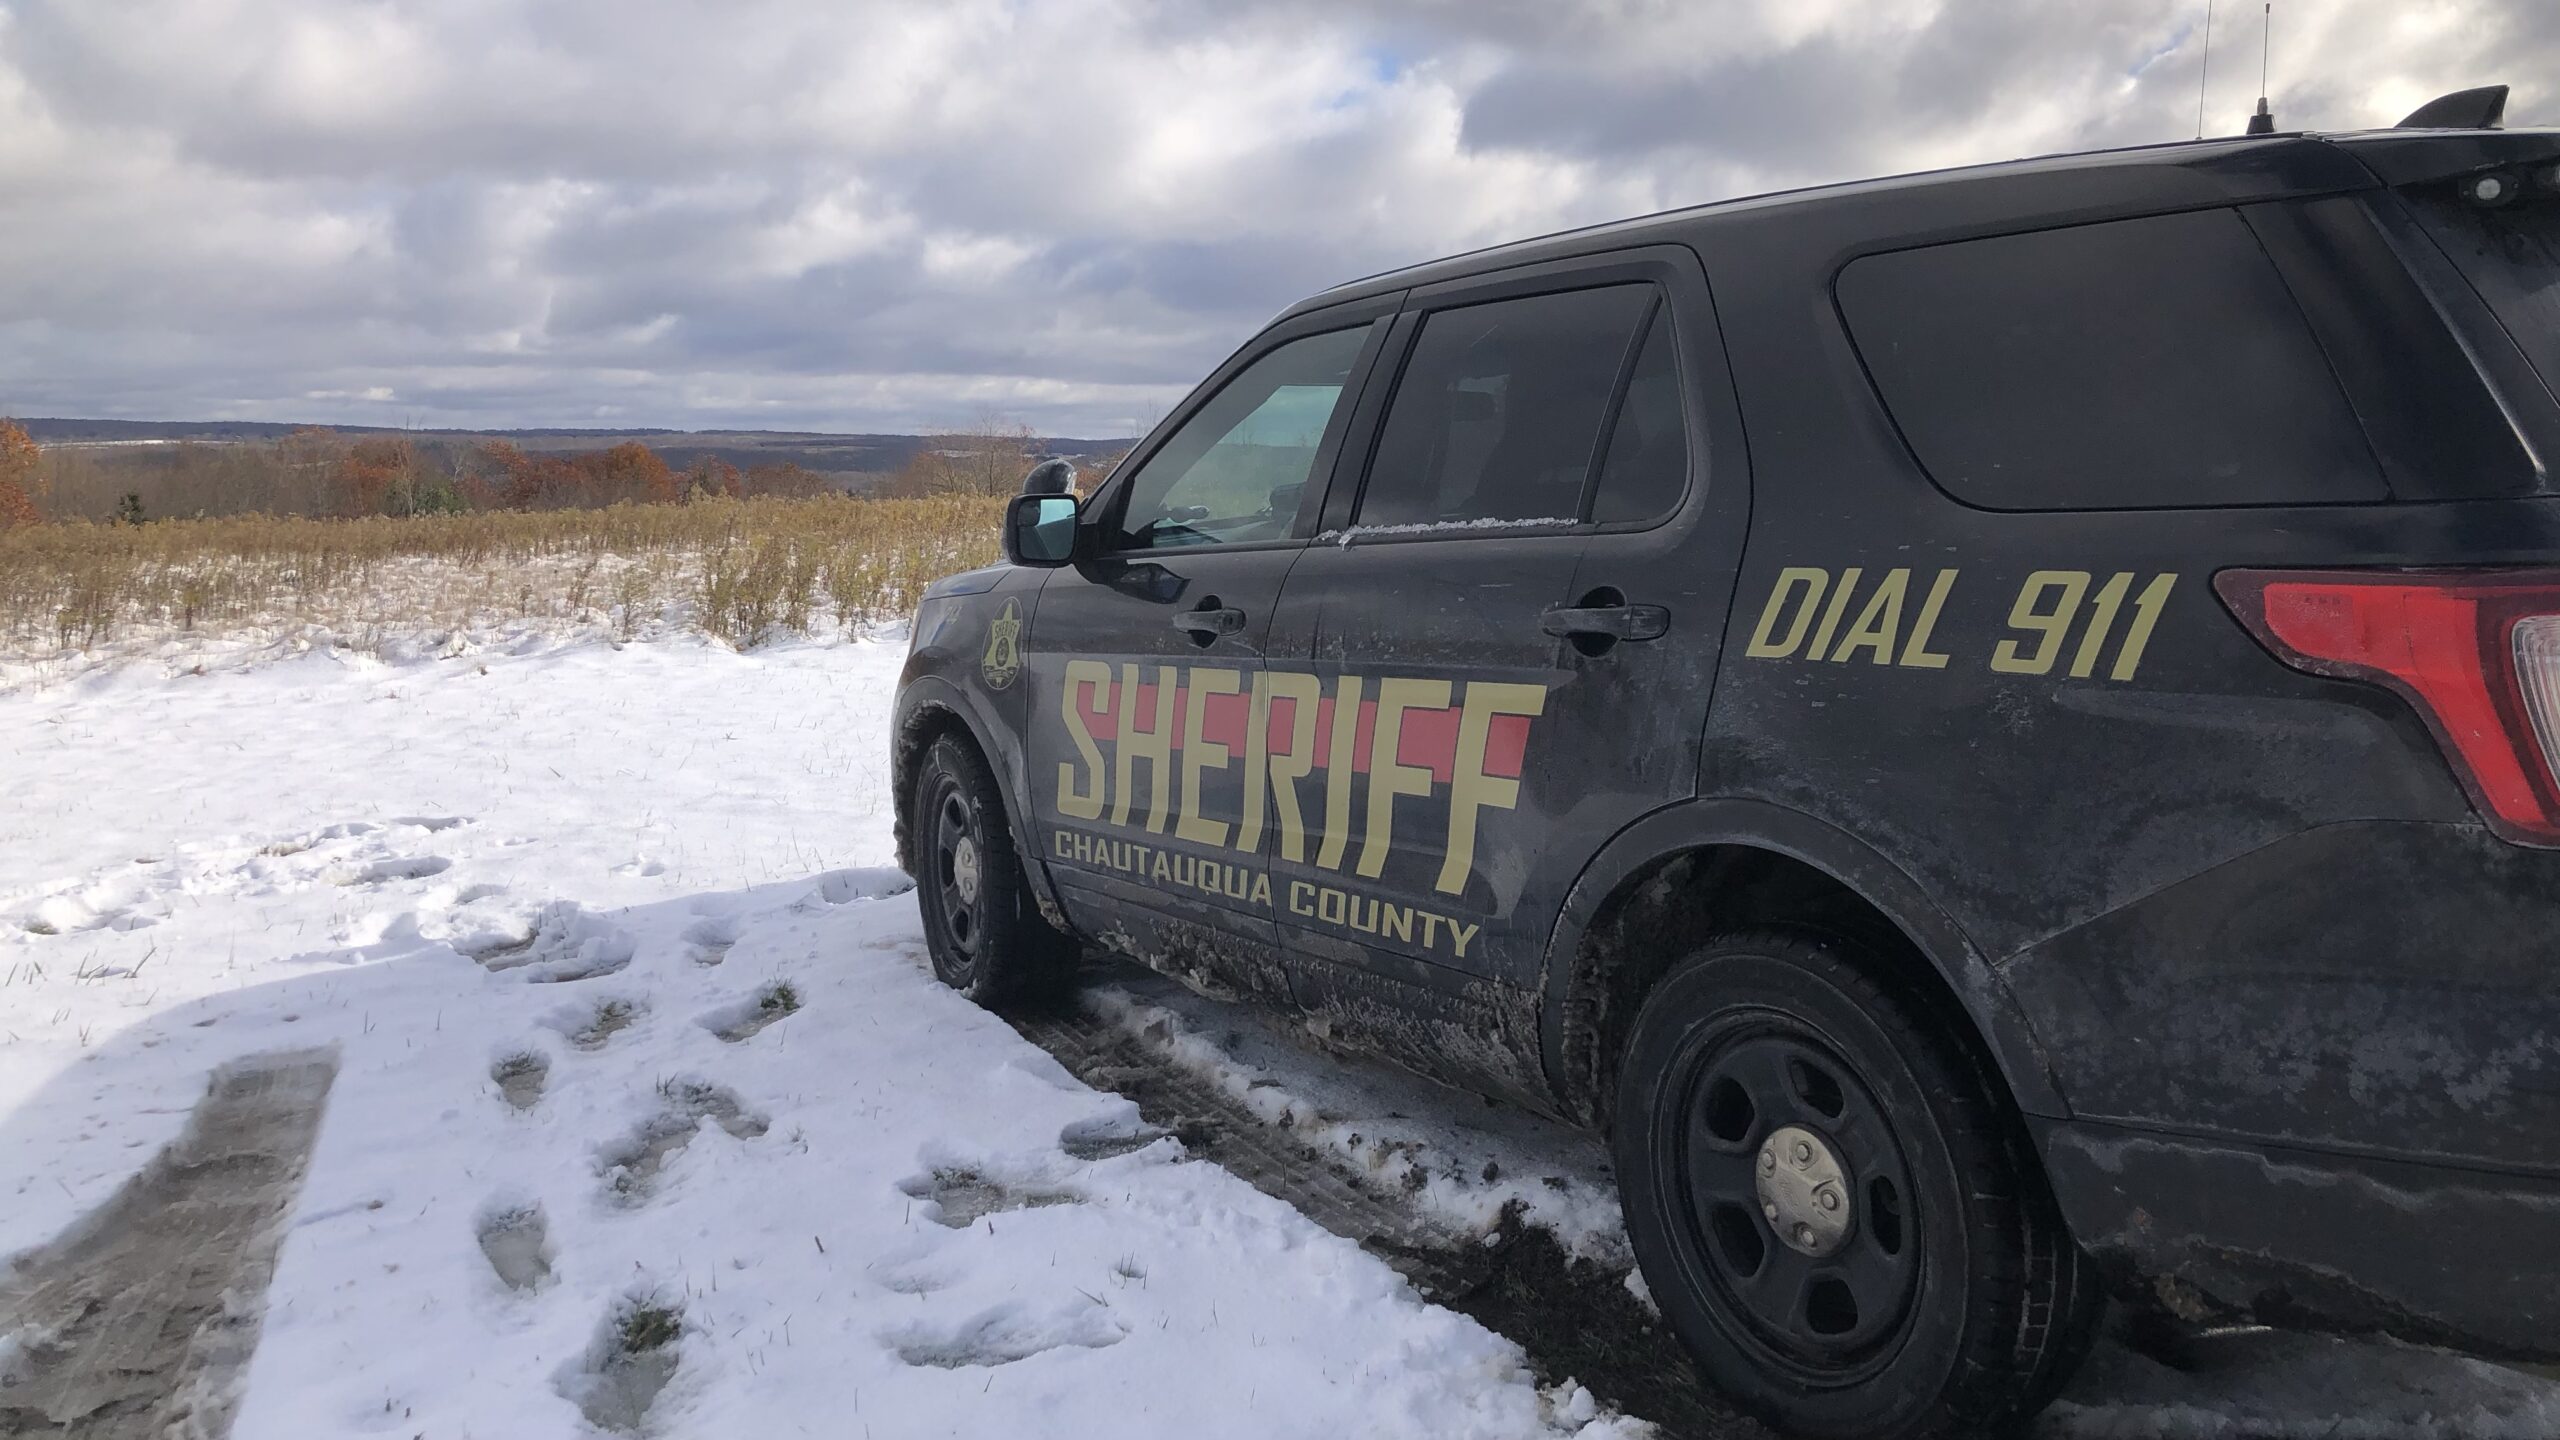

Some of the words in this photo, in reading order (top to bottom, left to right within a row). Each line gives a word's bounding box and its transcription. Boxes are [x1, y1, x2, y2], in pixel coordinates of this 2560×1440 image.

[994, 620, 1018, 640] SHERIFF
[1745, 567, 1960, 669] DIAL
[1990, 570, 2179, 681] 911
[1057, 660, 1548, 896] SHERIFF
[1055, 831, 1273, 908] CHAUTAUQUA
[1290, 881, 1480, 958] COUNTY
